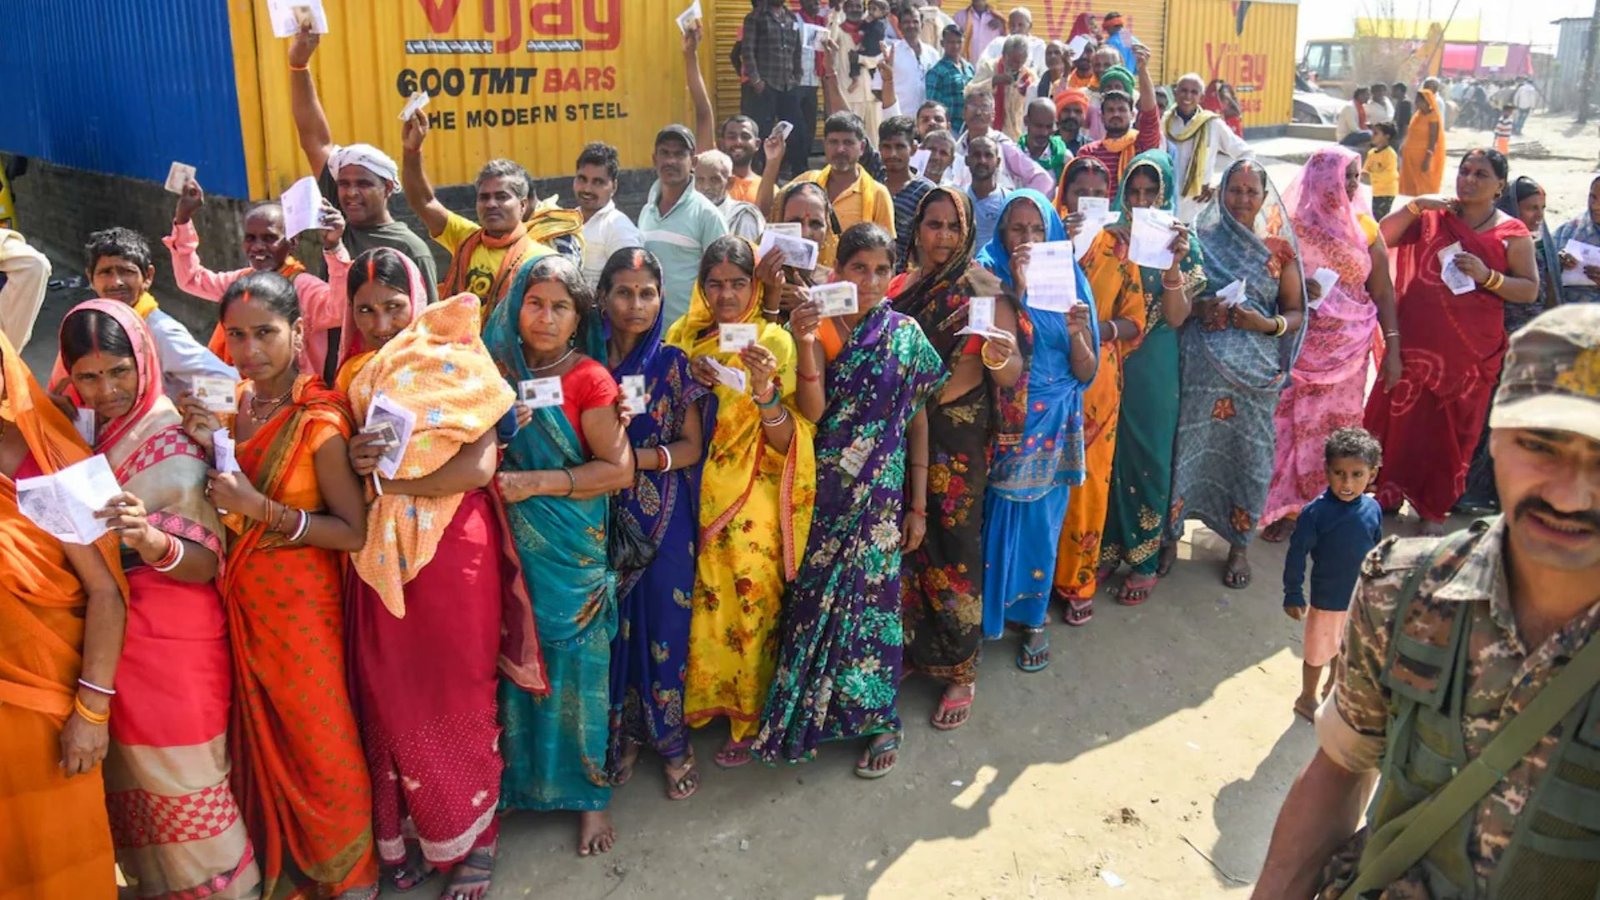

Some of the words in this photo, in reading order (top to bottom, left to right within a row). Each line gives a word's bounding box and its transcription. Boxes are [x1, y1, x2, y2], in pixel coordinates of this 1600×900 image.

[543, 66, 616, 93] BARS
[428, 111, 456, 130] HE
[566, 102, 628, 121] STEEL
